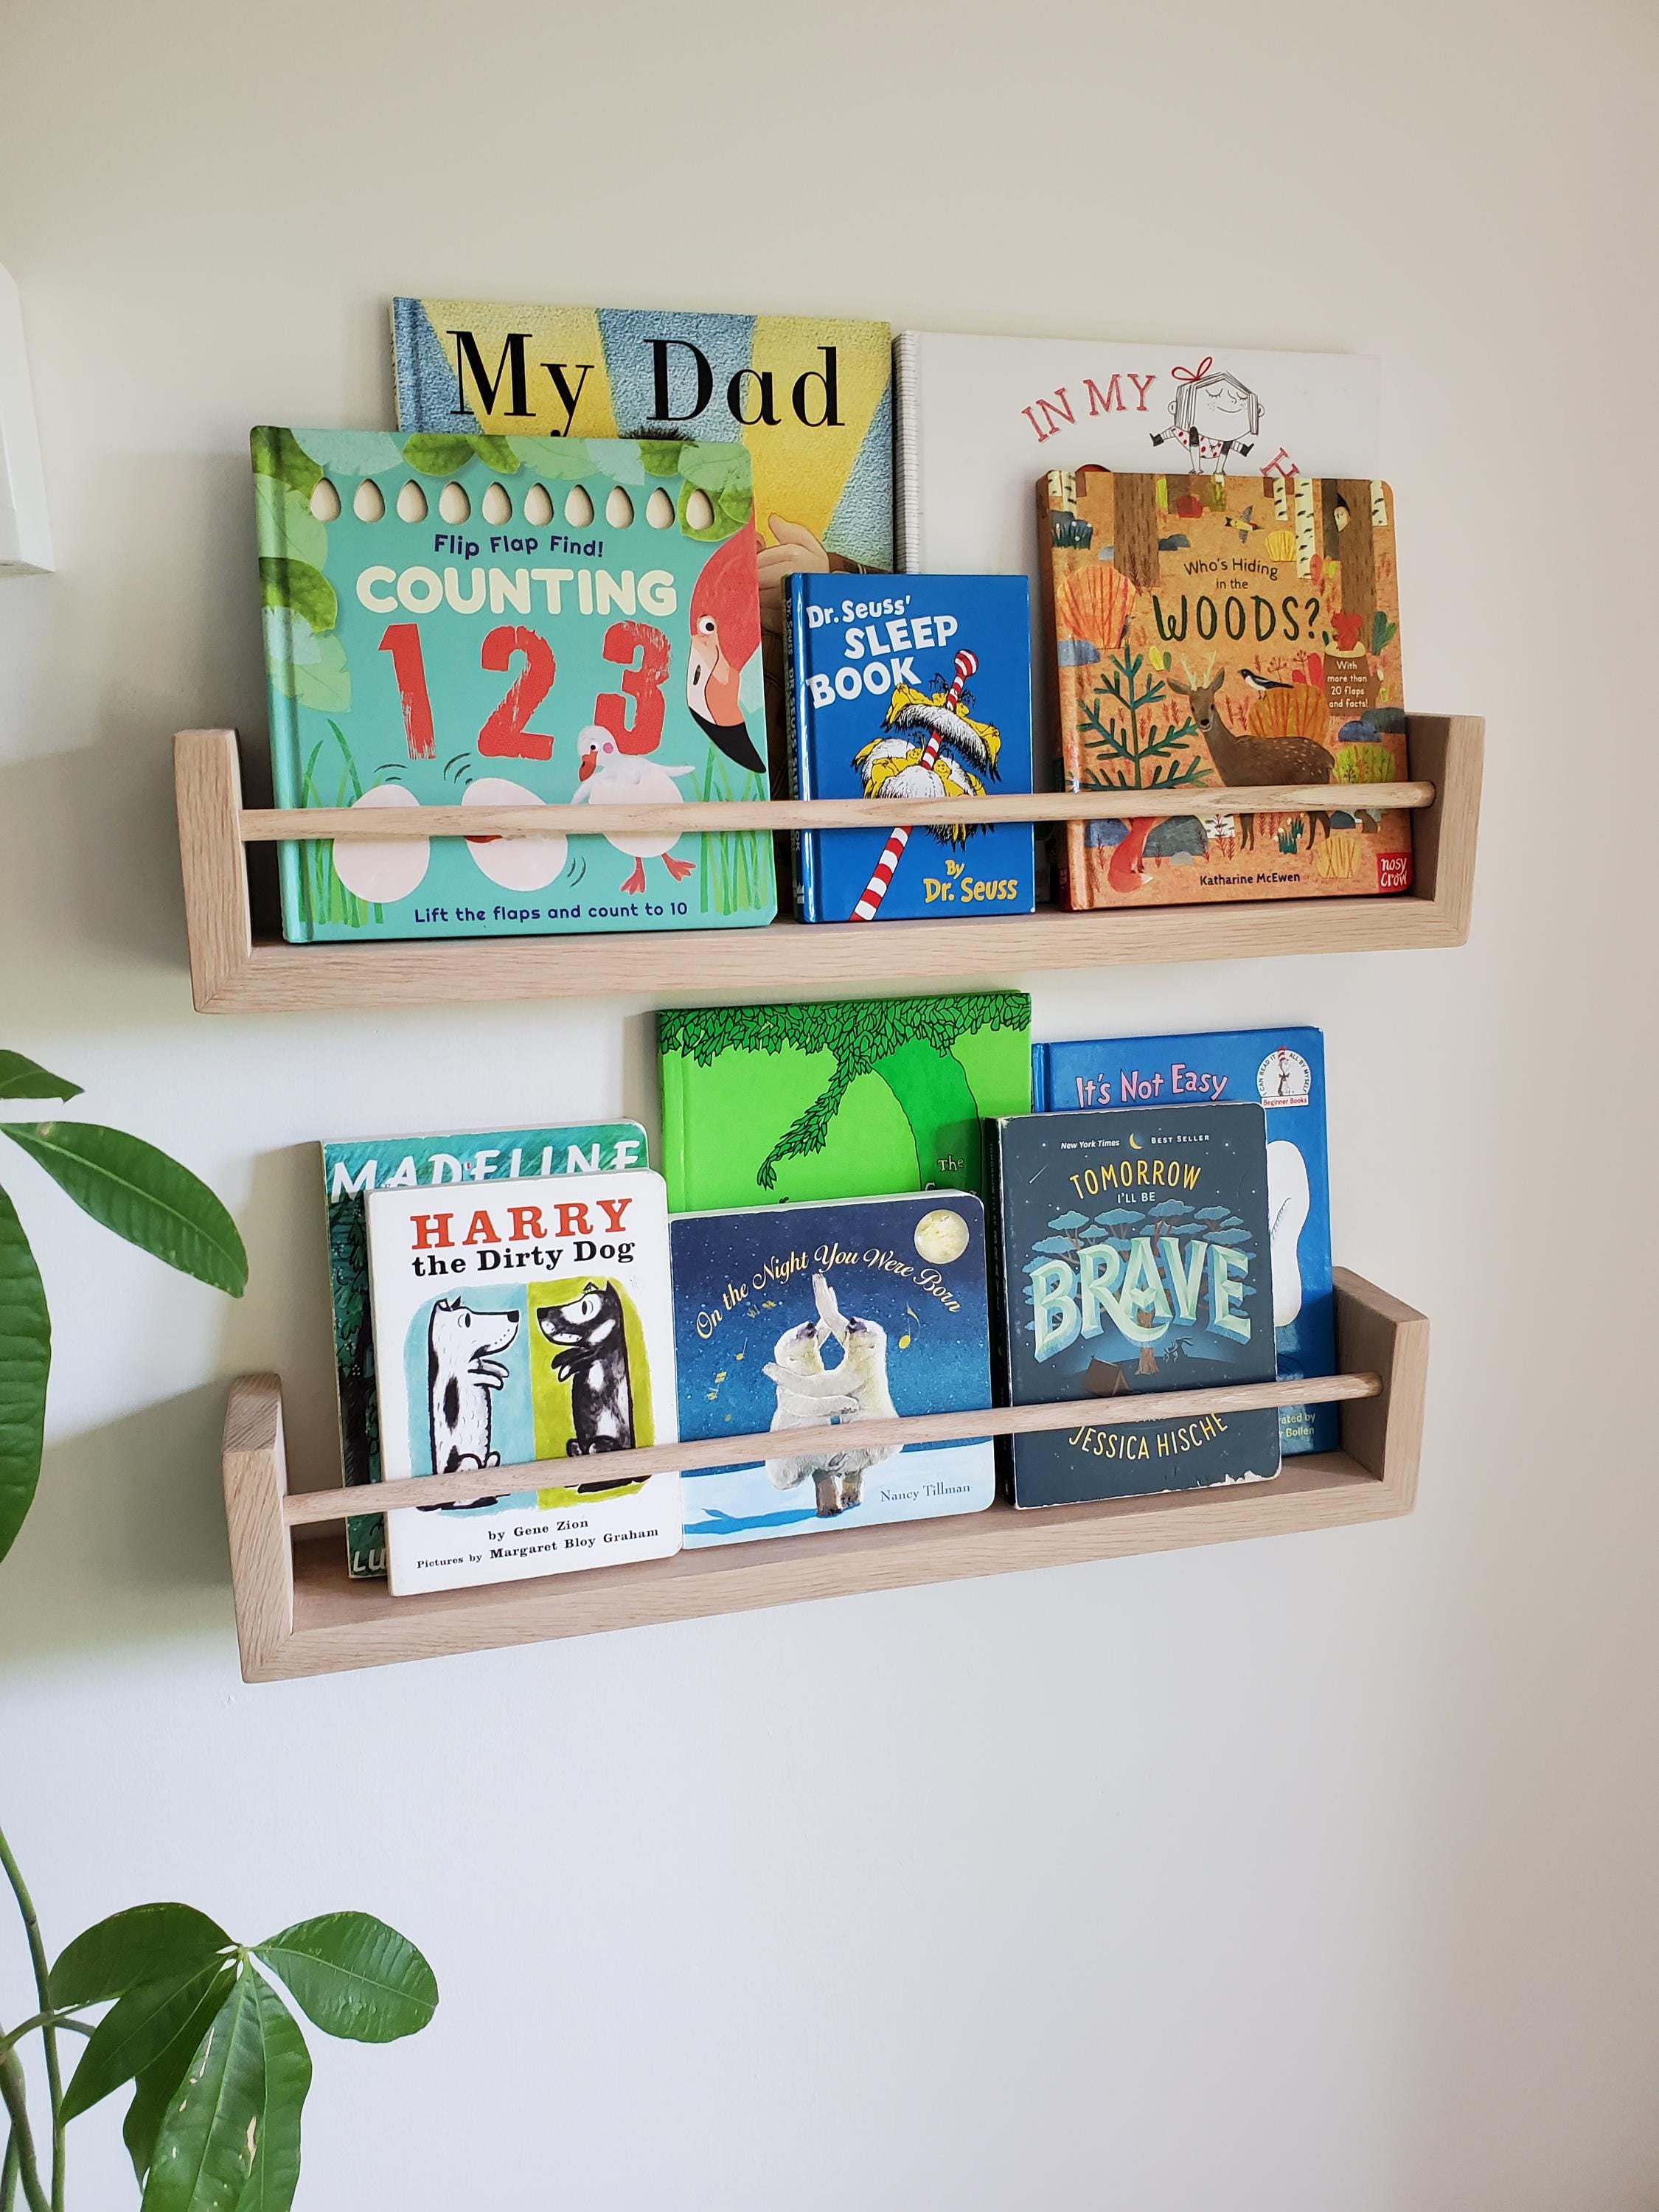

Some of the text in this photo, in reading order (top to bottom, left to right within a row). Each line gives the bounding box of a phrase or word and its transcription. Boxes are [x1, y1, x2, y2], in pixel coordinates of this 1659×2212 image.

[446, 330, 845, 437] My Dad
[1021, 374, 1157, 443] IN MY
[434, 533, 604, 560] Flip Flap Find!
[1183, 557, 1279, 581] Who's Hiding
[355, 565, 678, 616] COUNTING
[1216, 577, 1248, 590] in the
[806, 605, 839, 629] Dr.
[842, 595, 911, 624] Seuss'
[1152, 594, 1320, 642] WOODS?
[844, 615, 959, 661] SLEEP
[1336, 660, 1357, 669] With
[377, 622, 437, 760] 1
[477, 625, 556, 761] 2
[594, 619, 672, 756] 3
[806, 656, 922, 710] BOOK
[1350, 673, 1368, 683] than
[1329, 698, 1368, 708] and facts!
[1331, 686, 1365, 698] 20 flaps
[945, 859, 965, 877] By
[1200, 872, 1301, 886] Katharine McEwen
[1380, 858, 1407, 876] nosy
[1380, 870, 1407, 887] crow
[922, 876, 1018, 903] Dr. Seuss
[414, 902, 688, 923] Lift the flaps and count to 10
[1259, 1060, 1270, 1076] READ
[1289, 1053, 1298, 1061] ALL
[1298, 1060, 1306, 1068] BY
[1075, 1063, 1228, 1108] It's Not Easy
[1079, 1141, 1096, 1149] York
[1097, 1139, 1120, 1147] Times
[1177, 1135, 1210, 1143] SELLER
[330, 1140, 640, 1204] MADELINE
[937, 1155, 964, 1171] The
[1069, 1159, 1203, 1200] TOMORROW
[1117, 1192, 1156, 1204] I'LL BE
[409, 1197, 633, 1250] HARRY
[411, 1240, 636, 1277] the Dirty Dog
[696, 1242, 961, 1339] On the Night You Were Born
[1029, 1237, 1251, 1363] BRAVE
[1304, 1413, 1316, 1423] by
[1069, 1413, 1228, 1460] JESSICA HISCHE
[1285, 1426, 1315, 1438] Bollen
[880, 1481, 970, 1502] Nancy Tillman
[488, 1519, 589, 1542] by Gene Zion
[417, 1527, 659, 1569] Pictures by Margaret Bloy Graham
